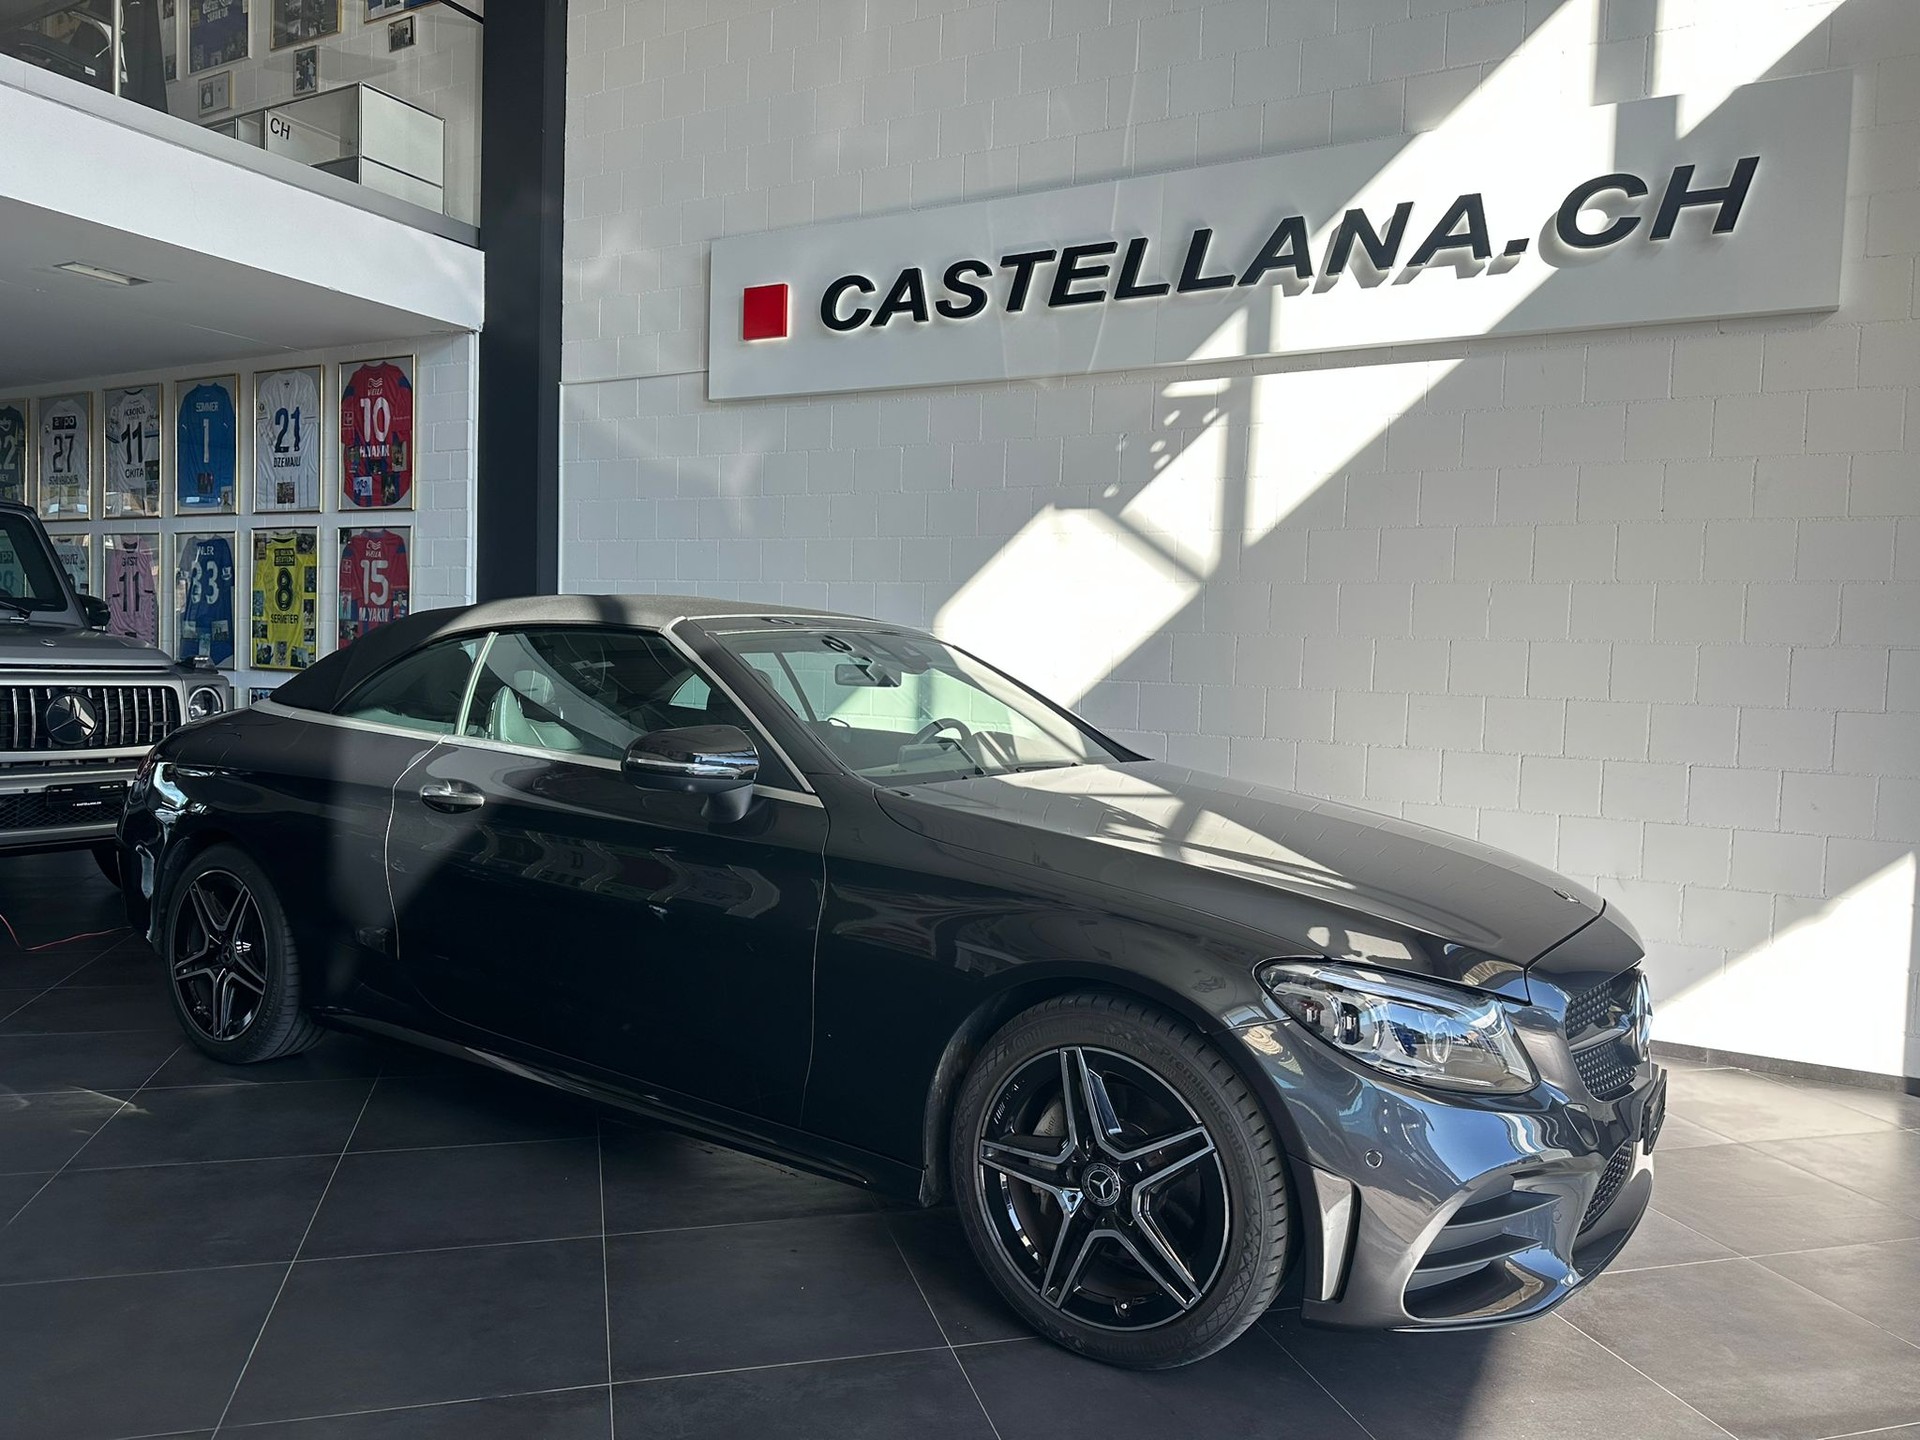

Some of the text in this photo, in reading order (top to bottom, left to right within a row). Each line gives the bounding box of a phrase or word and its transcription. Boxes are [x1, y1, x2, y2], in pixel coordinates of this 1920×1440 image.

[270, 117, 291, 141] CH
[820, 155, 1761, 331] CASTELLANA.CH
[203, 418, 210, 463] 1
[275, 406, 301, 453] 21
[360, 396, 391, 442] 10
[53, 433, 75, 473] 27
[121, 422, 143, 465] 11
[119, 571, 140, 612] 11
[275, 567, 293, 612] 8
[360, 560, 389, 606] 15
